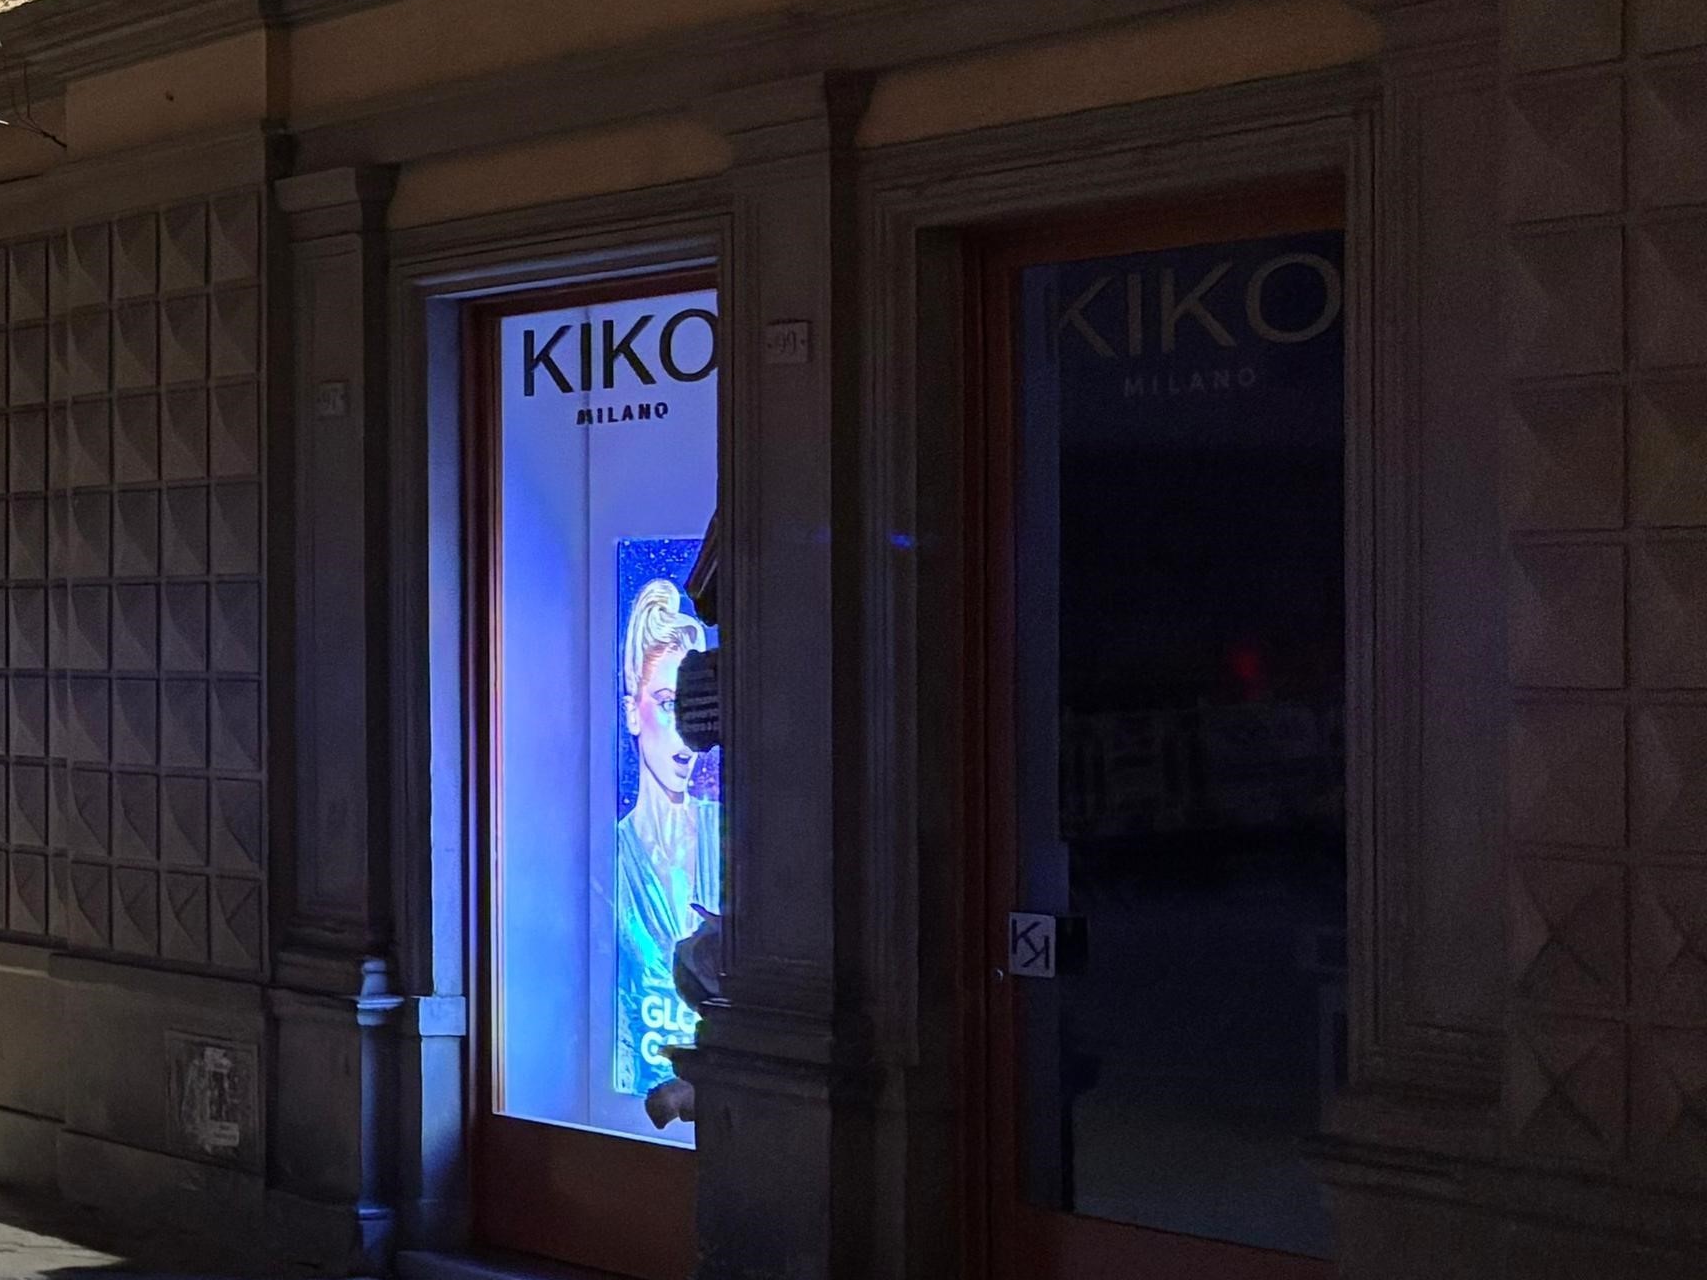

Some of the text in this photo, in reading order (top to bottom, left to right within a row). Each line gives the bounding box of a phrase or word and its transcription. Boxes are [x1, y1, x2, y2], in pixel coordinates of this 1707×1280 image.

[1051, 253, 1342, 358] KIKO
[523, 308, 718, 397] KIKO
[1124, 367, 1258, 397] MILANO
[576, 402, 669, 425] MILANO
